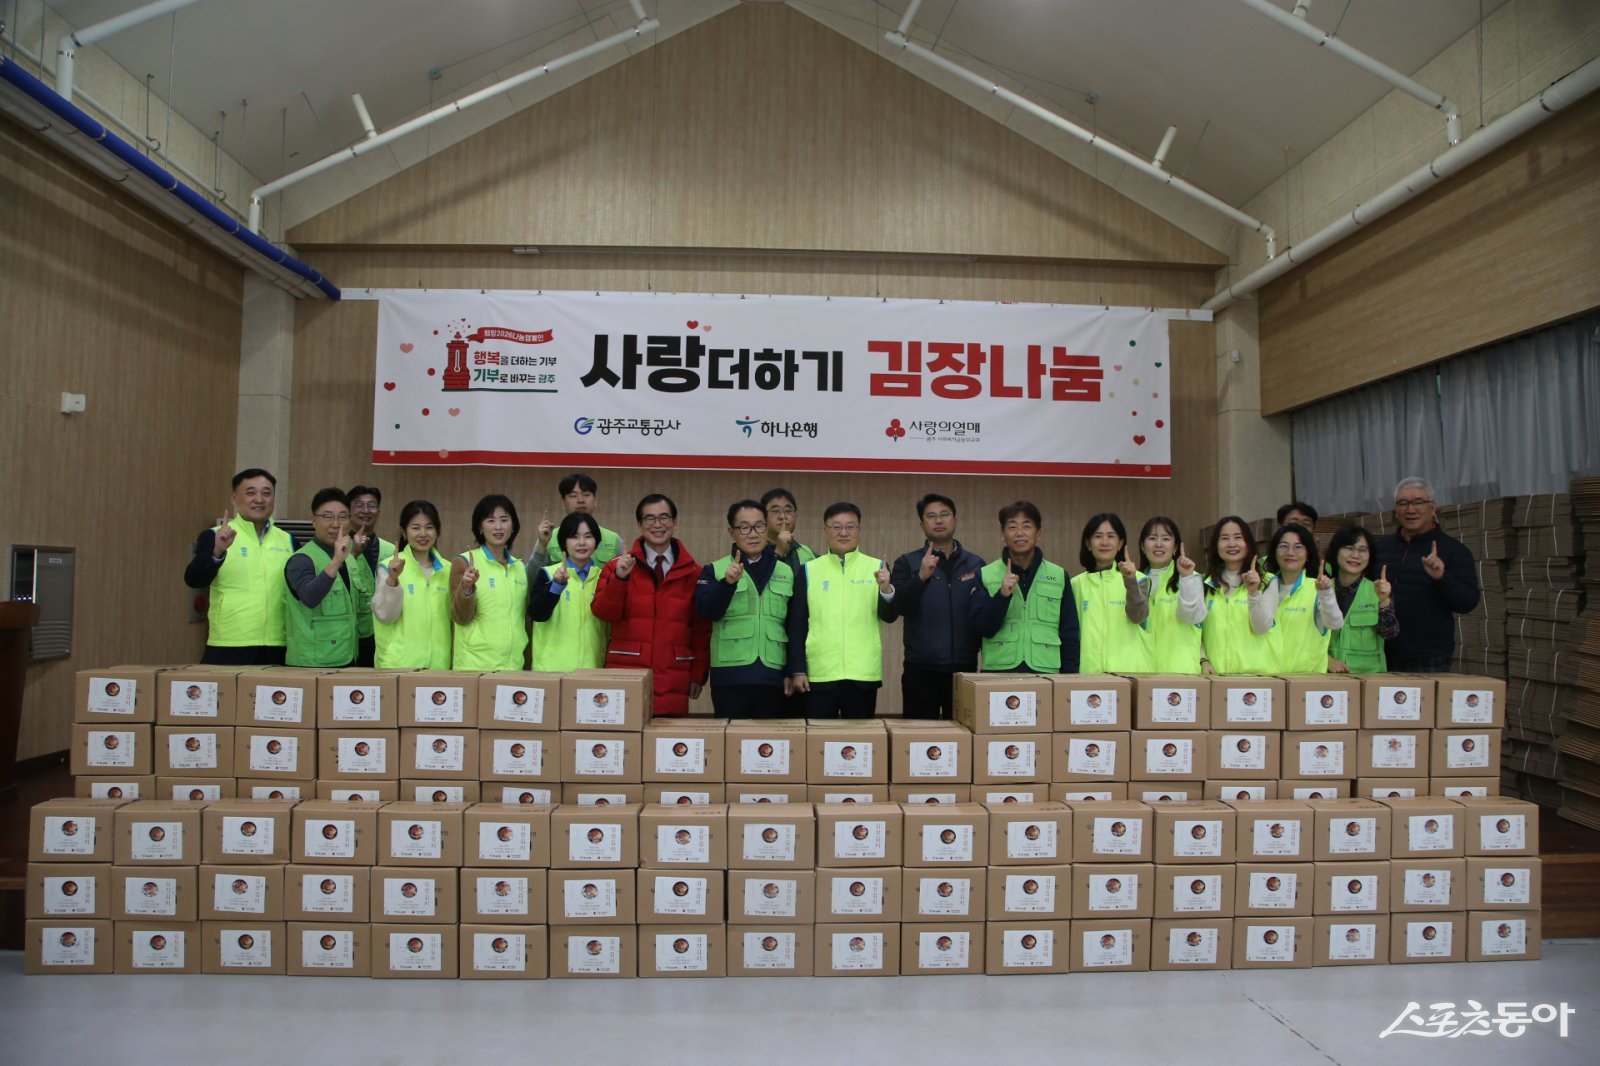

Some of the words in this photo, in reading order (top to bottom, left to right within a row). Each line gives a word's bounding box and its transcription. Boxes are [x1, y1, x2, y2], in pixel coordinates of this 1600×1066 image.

[474, 351, 509, 366] 행복을
[511, 356, 537, 366] 더하는
[539, 356, 557, 366] 기부
[474, 368, 509, 384] 기부로
[510, 374, 536, 384] 바꾸는
[538, 374, 556, 384] 광주
[867, 340, 1104, 402] 김장나눔
[597, 418, 681, 436] 광주교통공사
[761, 421, 818, 438] 하나은행
[909, 420, 981, 436] 사랑의열매
